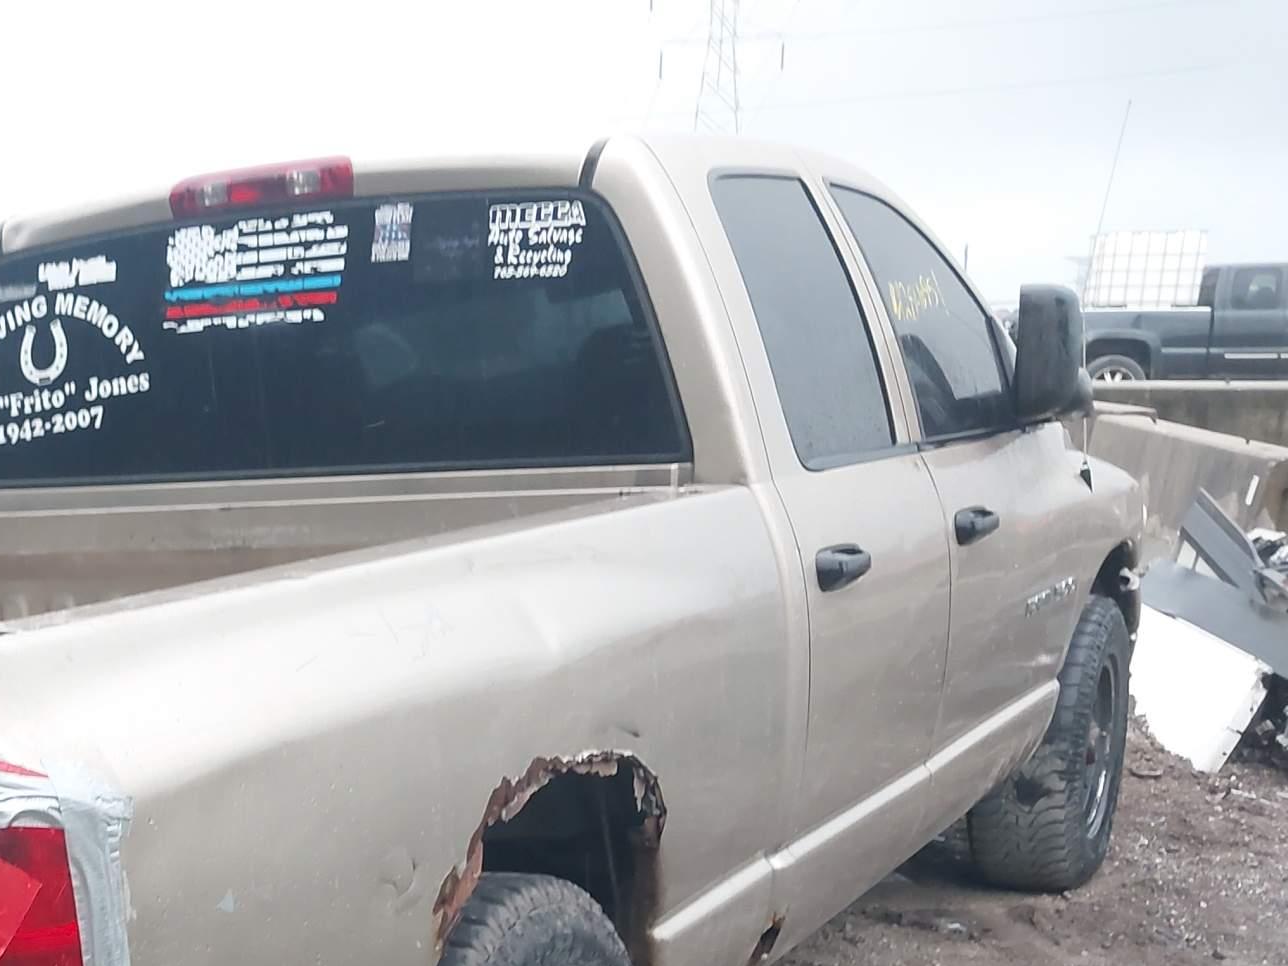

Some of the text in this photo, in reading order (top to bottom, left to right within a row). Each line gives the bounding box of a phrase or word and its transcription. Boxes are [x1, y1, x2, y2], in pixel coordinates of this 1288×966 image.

[528, 226, 583, 246] Salvage
[494, 245, 504, 264] &
[54, 293, 145, 364] MEMORY
[84, 373, 150, 402] Jones
